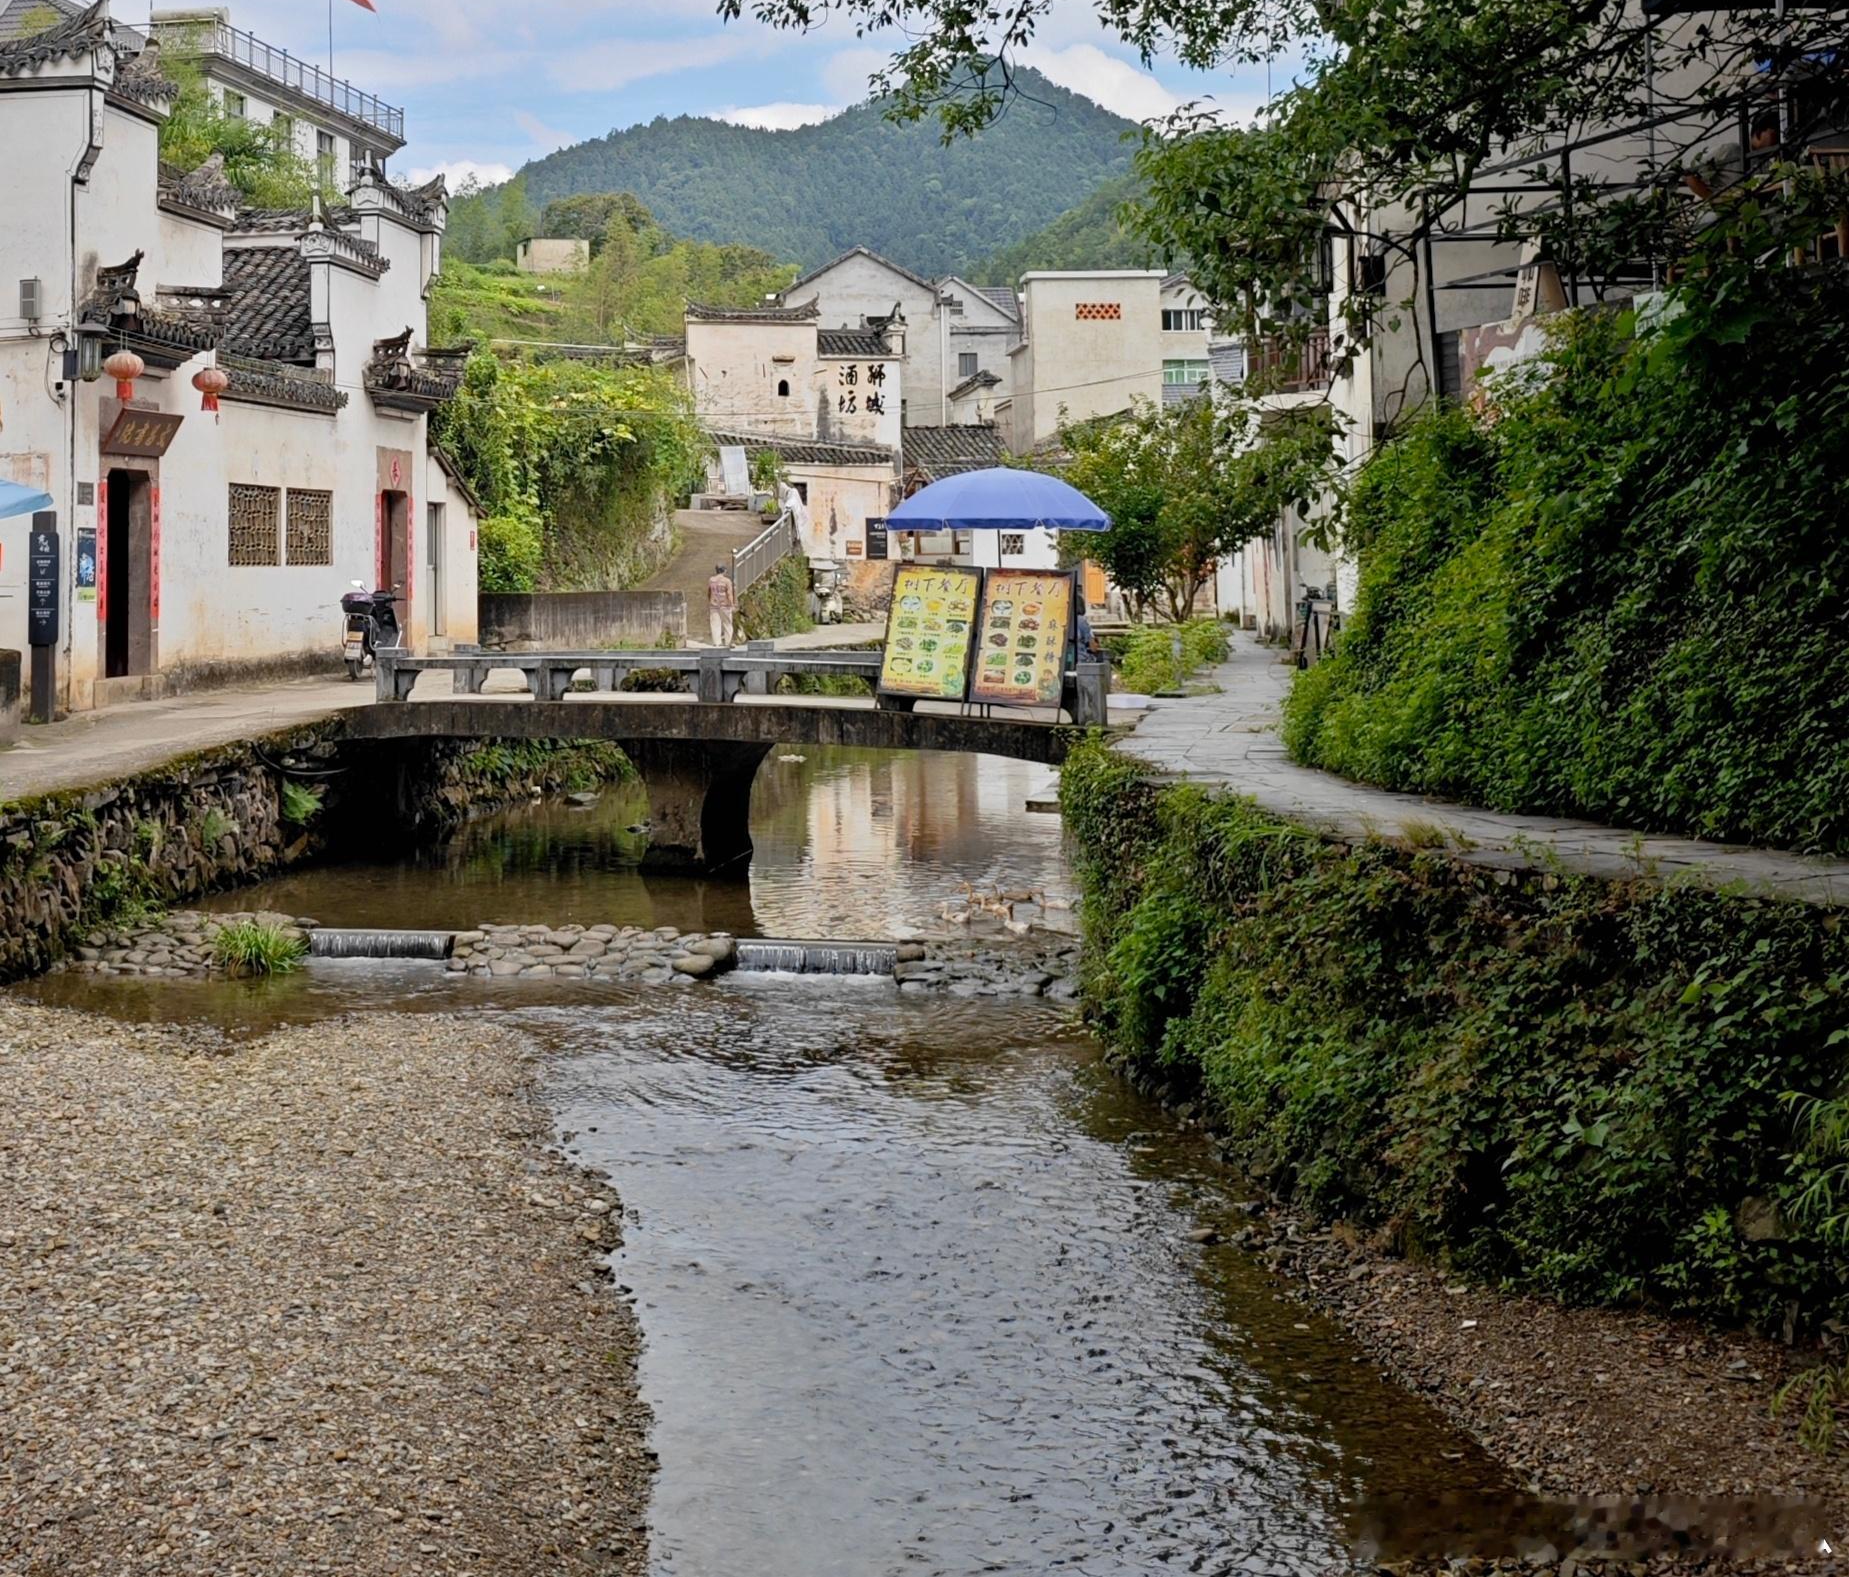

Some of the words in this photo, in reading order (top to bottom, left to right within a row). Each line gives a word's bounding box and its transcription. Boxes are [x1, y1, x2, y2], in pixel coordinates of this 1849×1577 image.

[838, 364, 857, 414] 酒坊
[904, 578, 969, 594] 树下餐厅
[996, 581, 1061, 597] 树下餐厅
